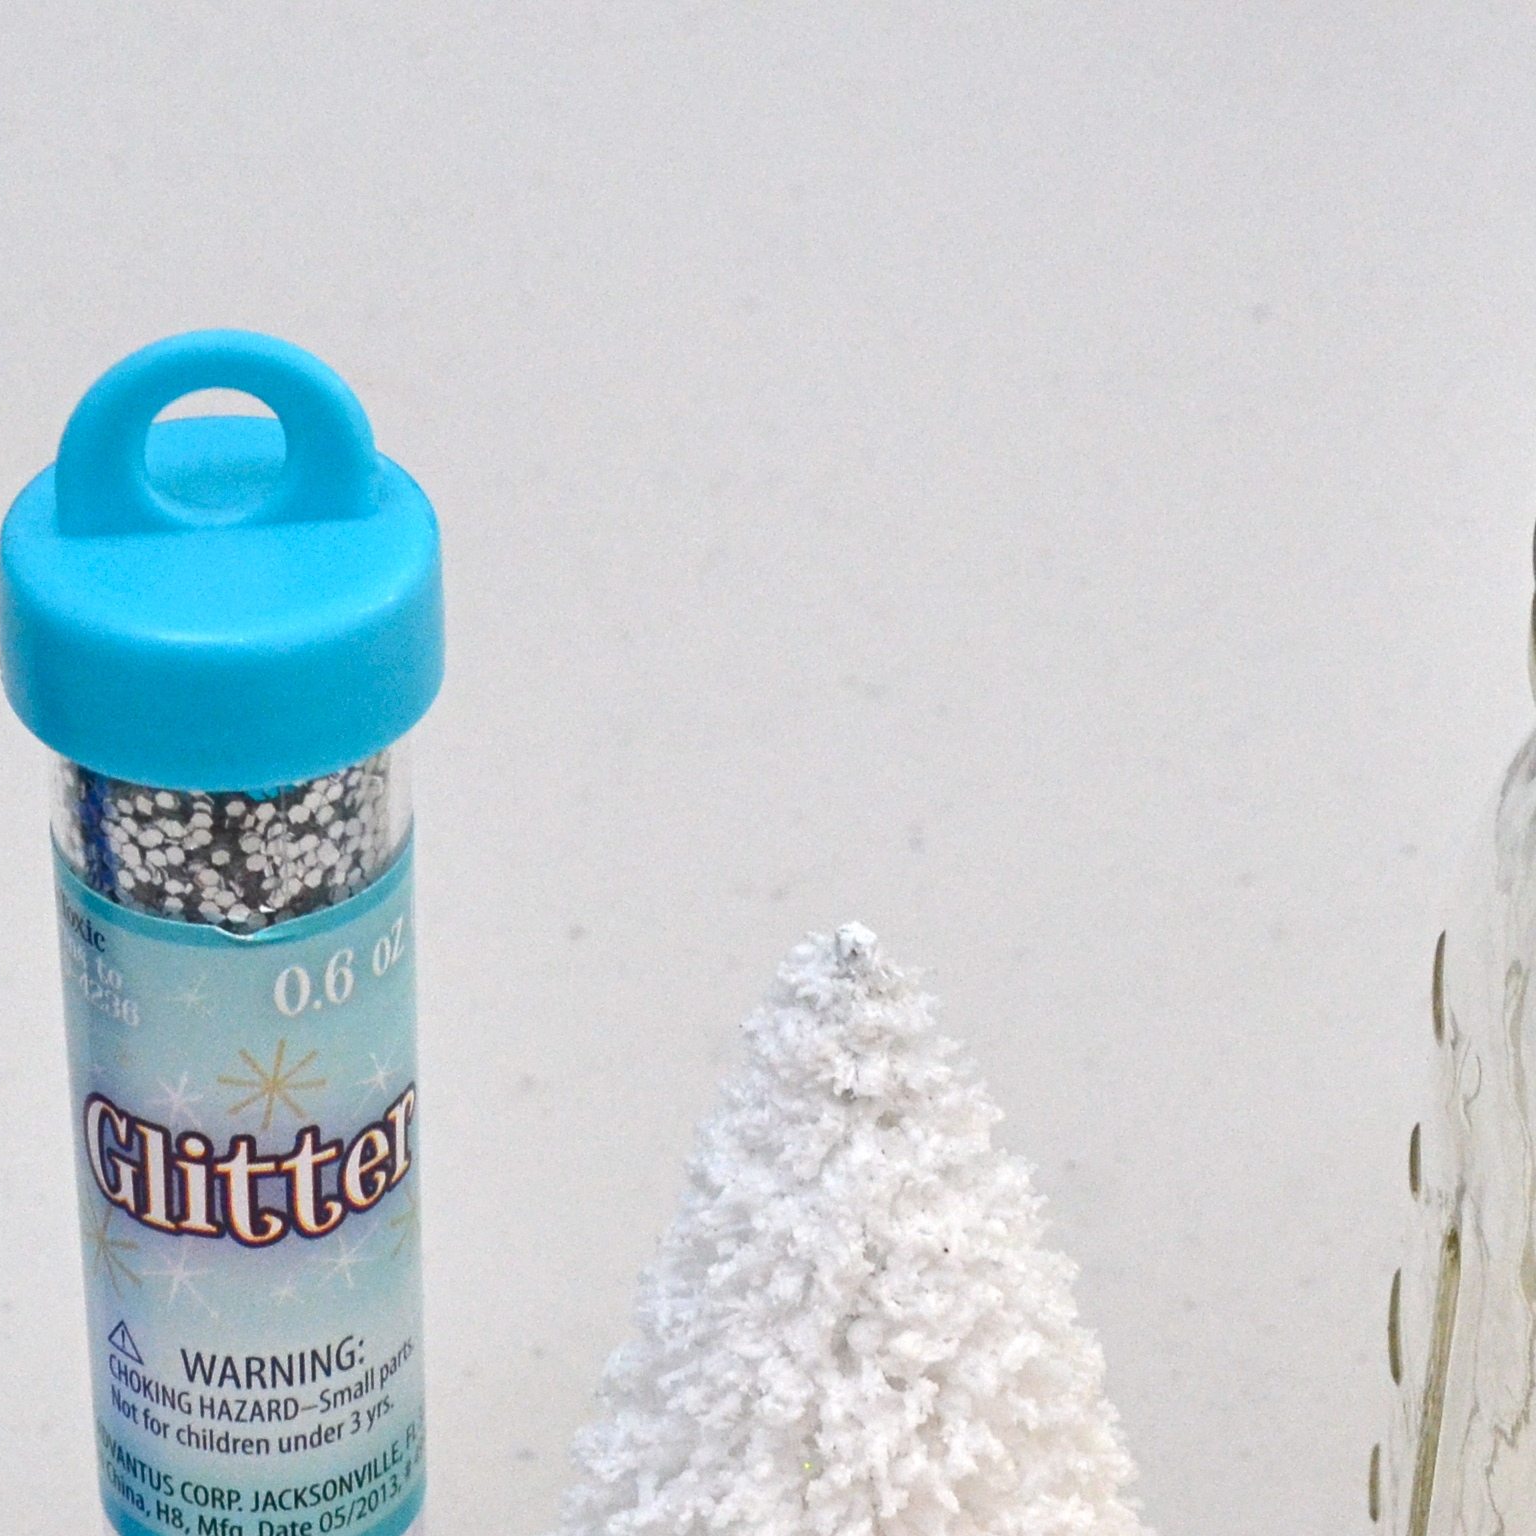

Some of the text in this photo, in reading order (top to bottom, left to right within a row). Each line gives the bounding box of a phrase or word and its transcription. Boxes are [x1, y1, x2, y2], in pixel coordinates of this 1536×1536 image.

[274, 948, 356, 1017] 0.6
[83, 1082, 416, 1248] Glitter
[109, 1354, 192, 1415] CHOKING
[180, 1335, 365, 1390] WARNING:
[110, 1385, 139, 1425] Not
[142, 1408, 170, 1439] for
[176, 1424, 270, 1455] children
[278, 1421, 343, 1454] under
[350, 1411, 361, 1434] 3
[366, 1394, 394, 1432] yrs.
[106, 1461, 151, 1517] China,
[156, 1500, 190, 1534] H8,
[319, 1473, 402, 1534] 05/2013,
[181, 1481, 243, 1512] CORP.
[250, 1440, 403, 1513] JACKSONVILLE,
